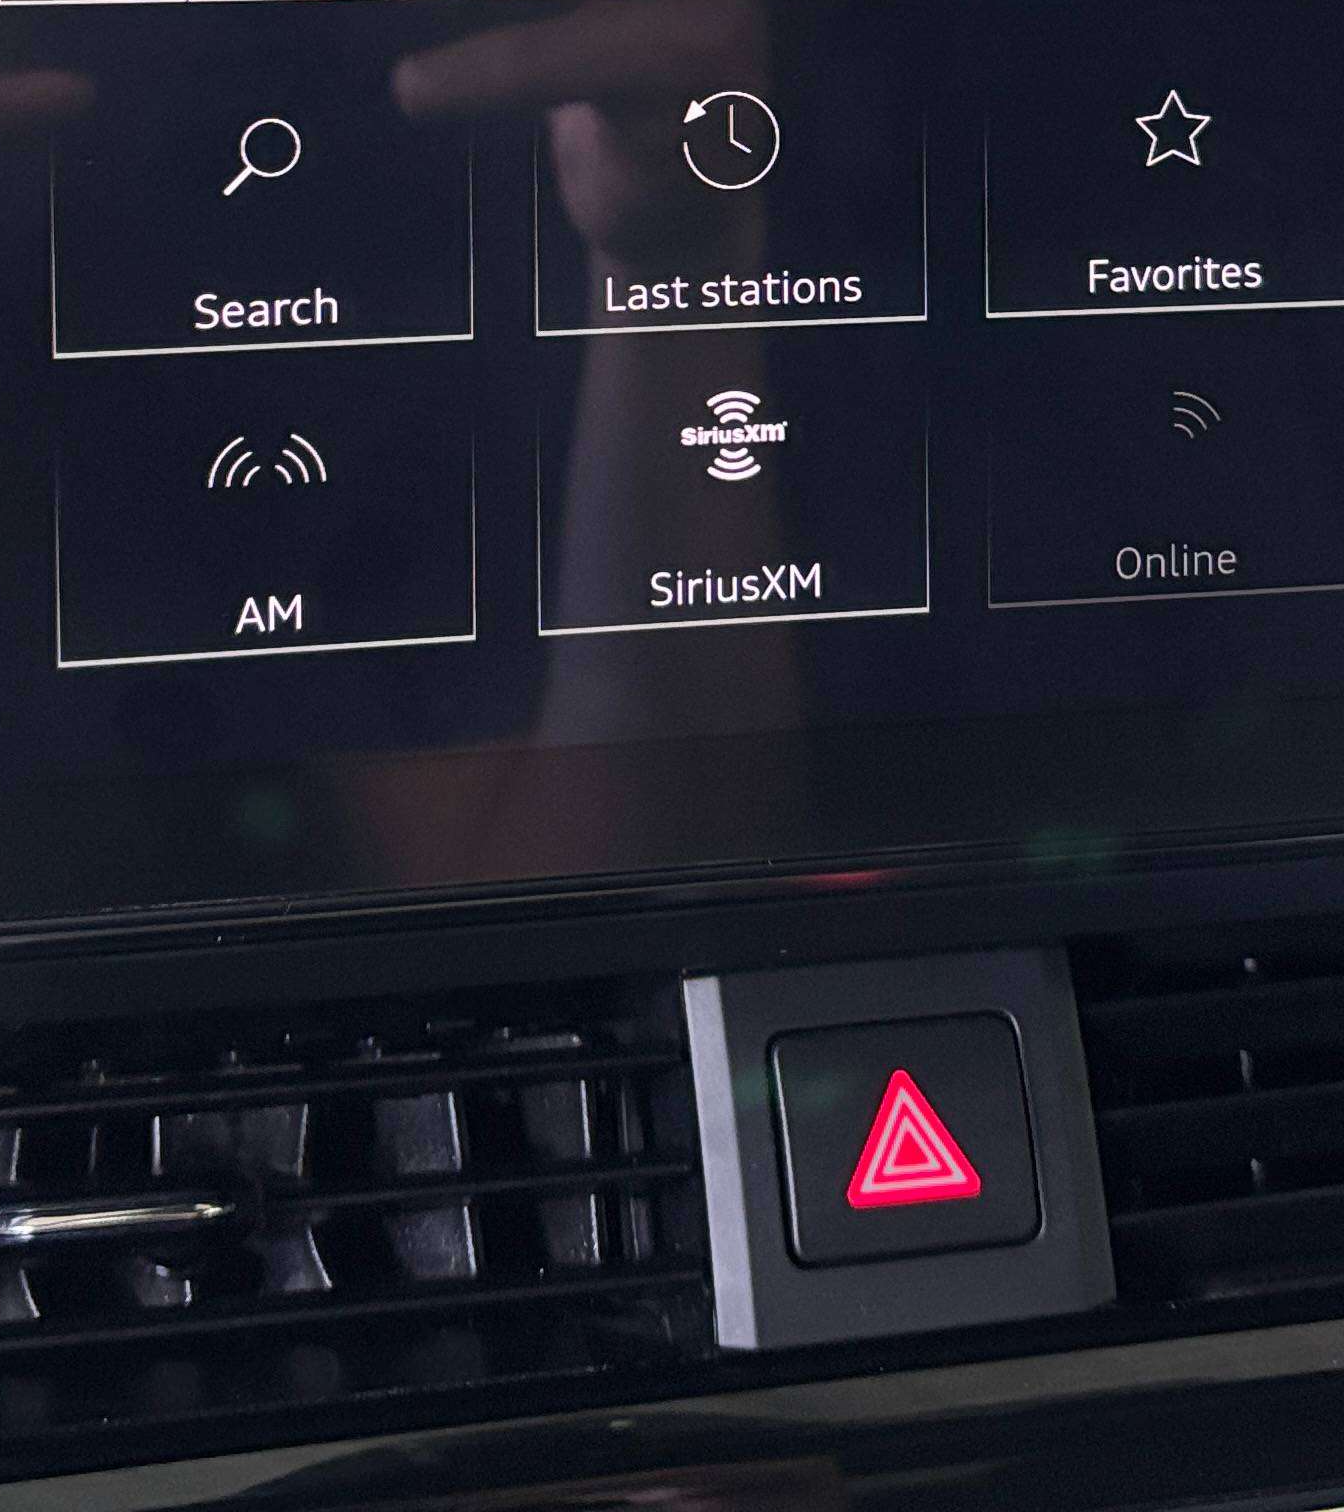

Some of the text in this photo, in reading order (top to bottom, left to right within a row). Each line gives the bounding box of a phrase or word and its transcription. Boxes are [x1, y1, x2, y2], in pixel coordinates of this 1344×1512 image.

[605, 269, 864, 313] Last stations
[1088, 255, 1265, 296] Favorites
[193, 286, 341, 332] Search
[1115, 542, 1239, 582] Online
[649, 561, 823, 609] SiriusXM
[234, 593, 306, 637] AM
